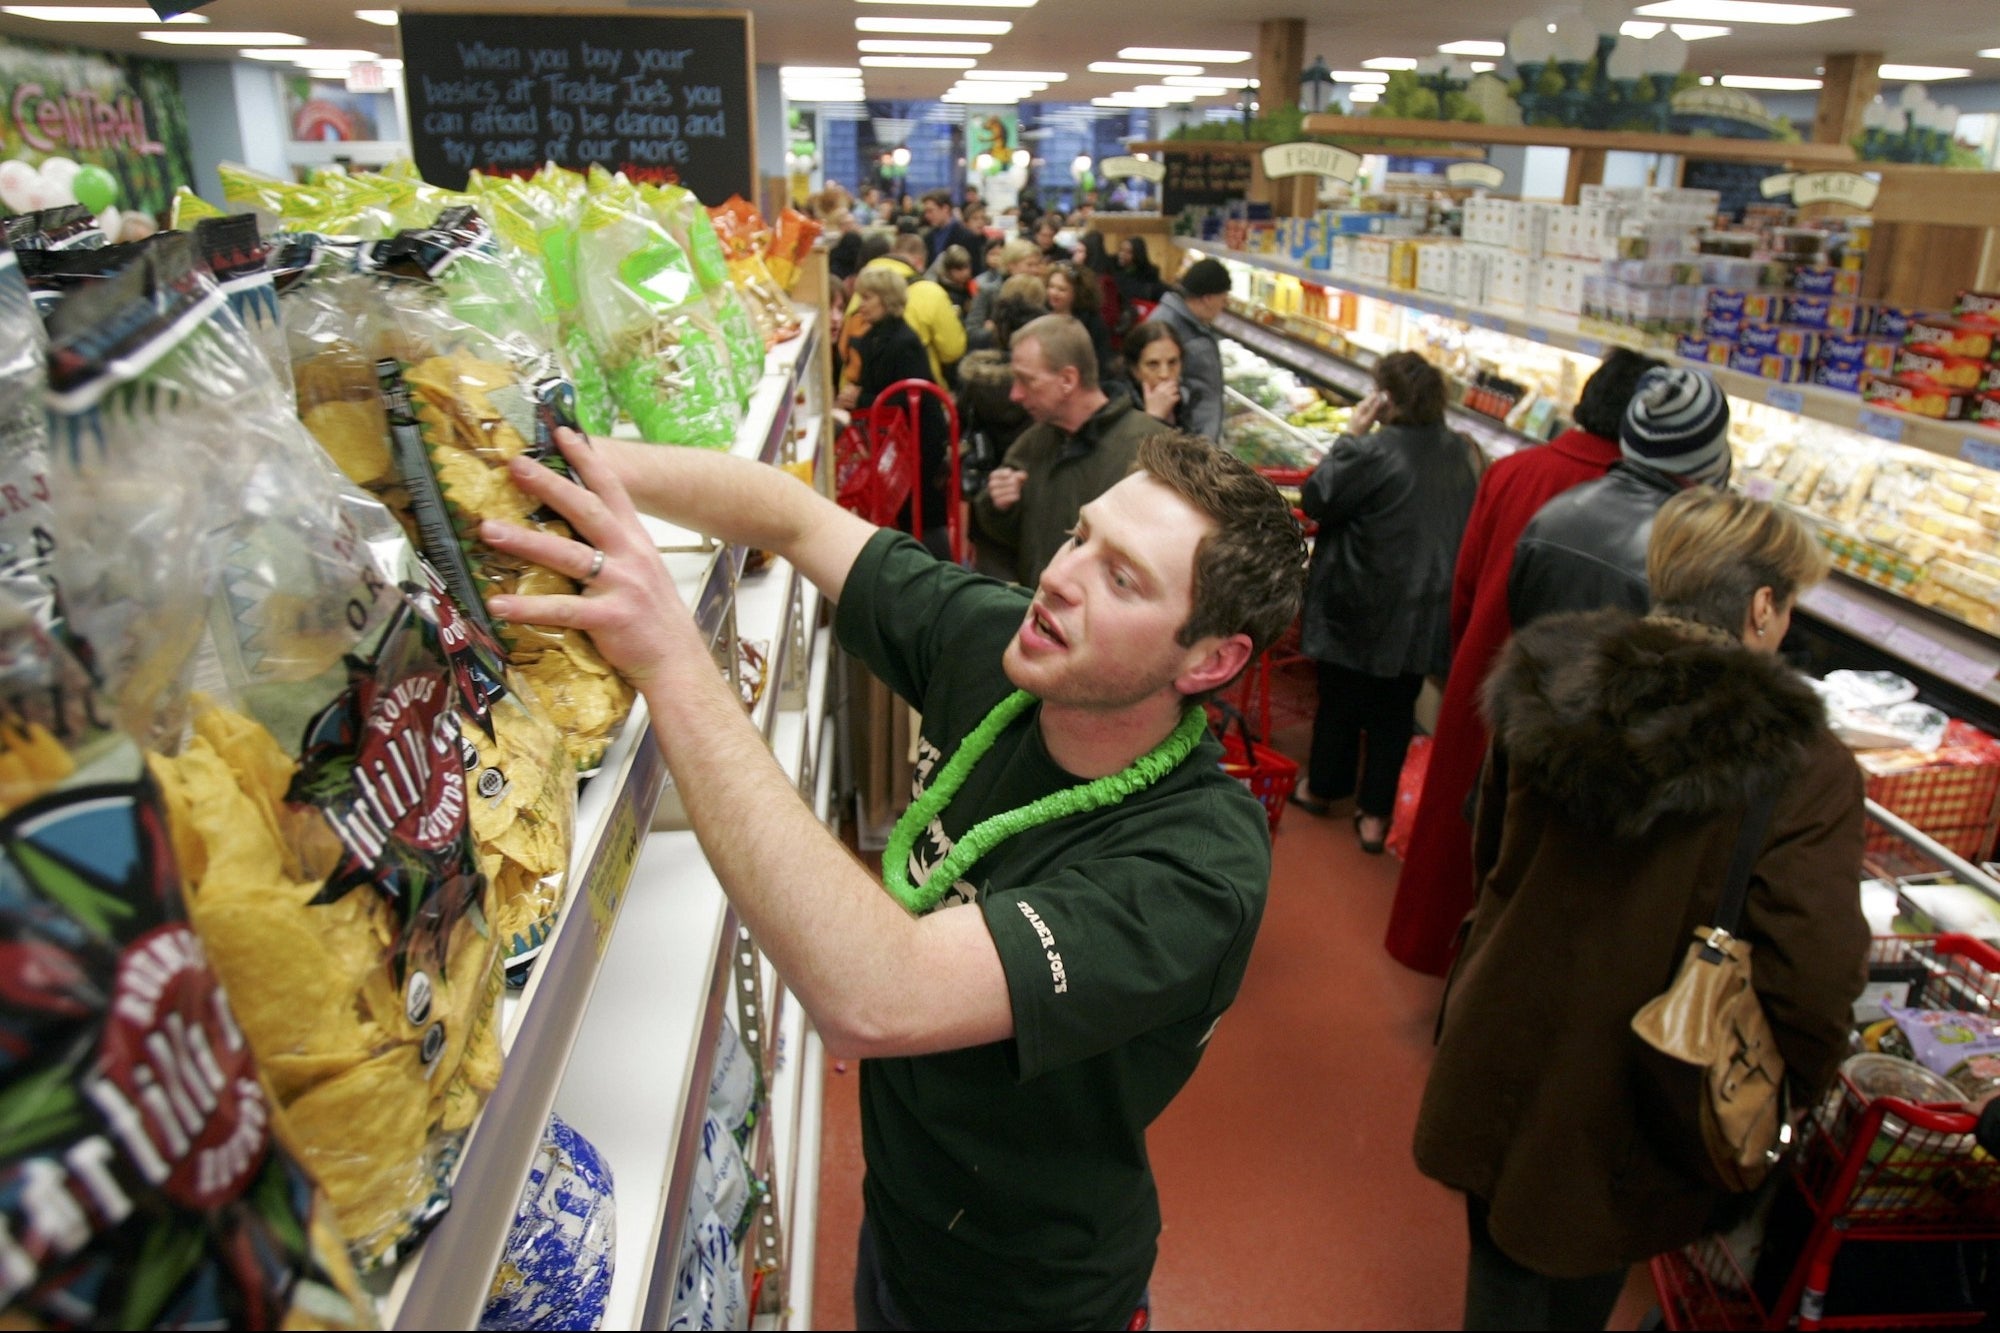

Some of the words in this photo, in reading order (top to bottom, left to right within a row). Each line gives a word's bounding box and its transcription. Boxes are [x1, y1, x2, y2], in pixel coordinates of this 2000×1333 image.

[457, 40, 520, 69] When
[528, 48, 569, 74] you
[580, 40, 623, 74] buy
[633, 48, 693, 74] your
[422, 73, 499, 105] basics
[506, 75, 536, 103] at
[543, 73, 617, 105] Trader
[620, 74, 673, 107] Joe's
[682, 85, 722, 110] you
[424, 111, 464, 134] can
[470, 104, 539, 134] afford
[548, 106, 575, 134] to
[580, 104, 609, 135] be
[614, 108, 680, 140] daring
[684, 110, 726, 138] and
[442, 137, 476, 168] try
[481, 138, 536, 163] some
[544, 133, 570, 160] of
[577, 138, 619, 161] our
[1285, 147, 1342, 171] FRUIT
[1016, 900, 1056, 949] TRADER
[1046, 949, 1068, 994] JOE'S
